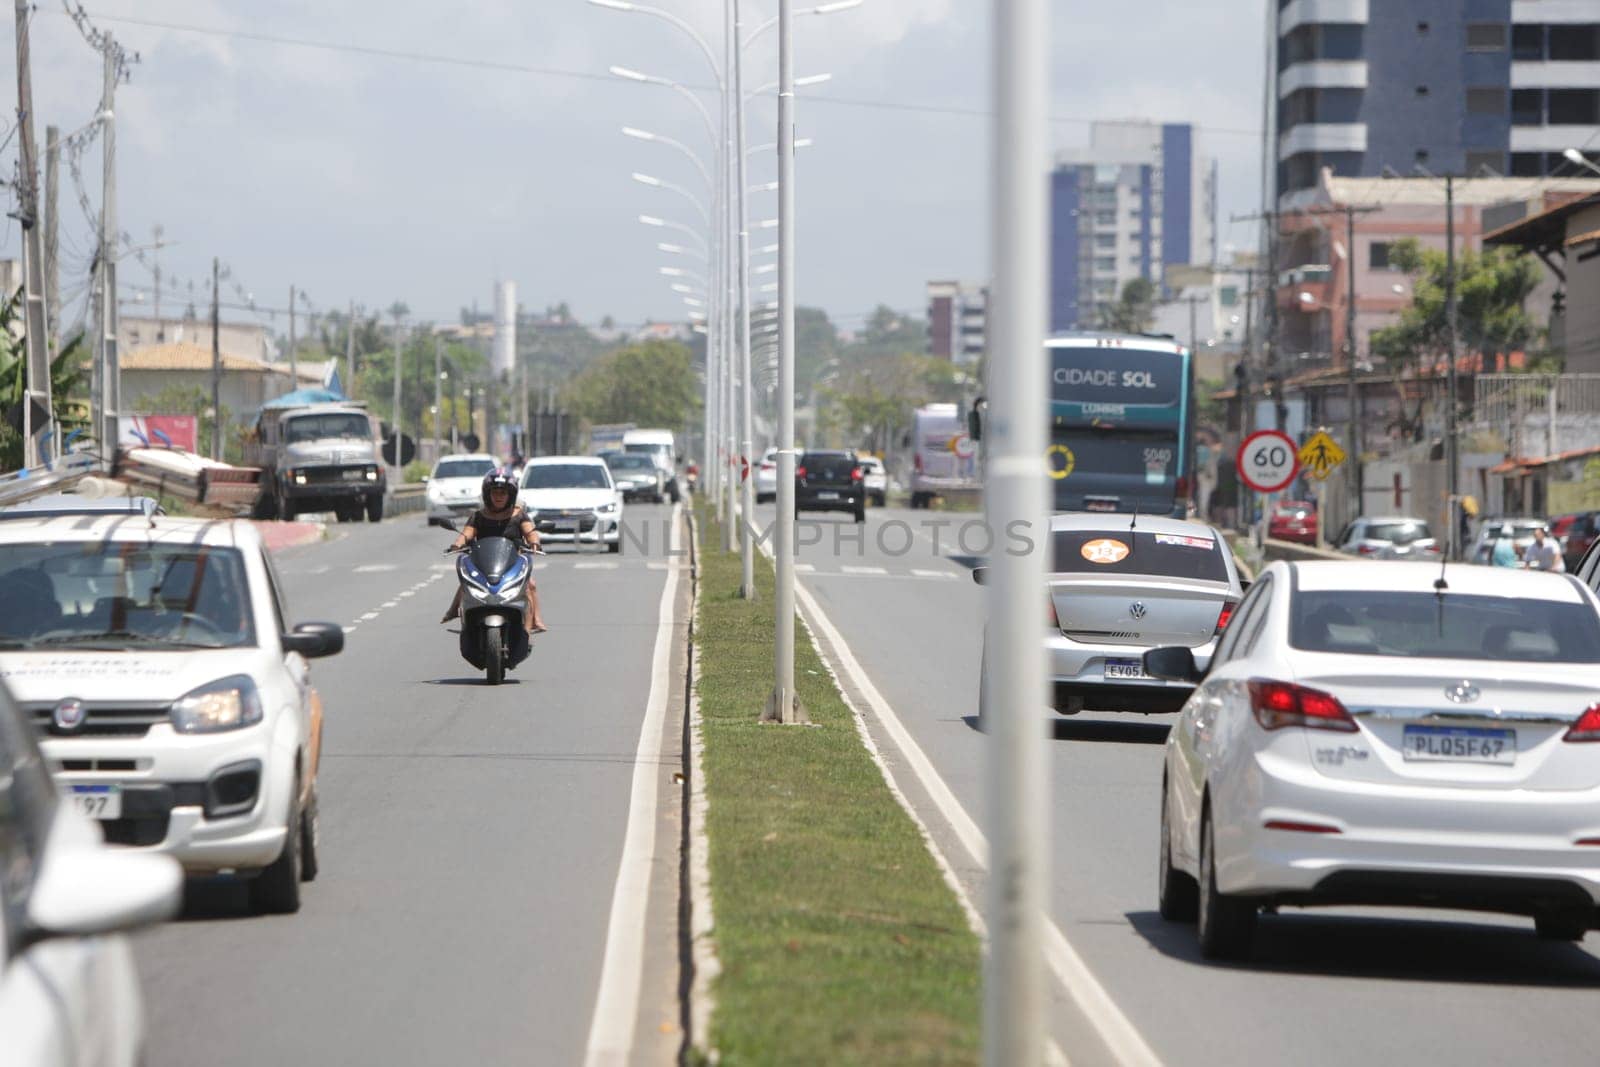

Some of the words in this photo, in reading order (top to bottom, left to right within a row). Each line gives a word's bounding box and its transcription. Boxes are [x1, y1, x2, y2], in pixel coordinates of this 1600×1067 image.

[1054, 367, 1117, 387] CIDADE
[1122, 370, 1156, 388] SOL
[1254, 446, 1287, 468] 60
